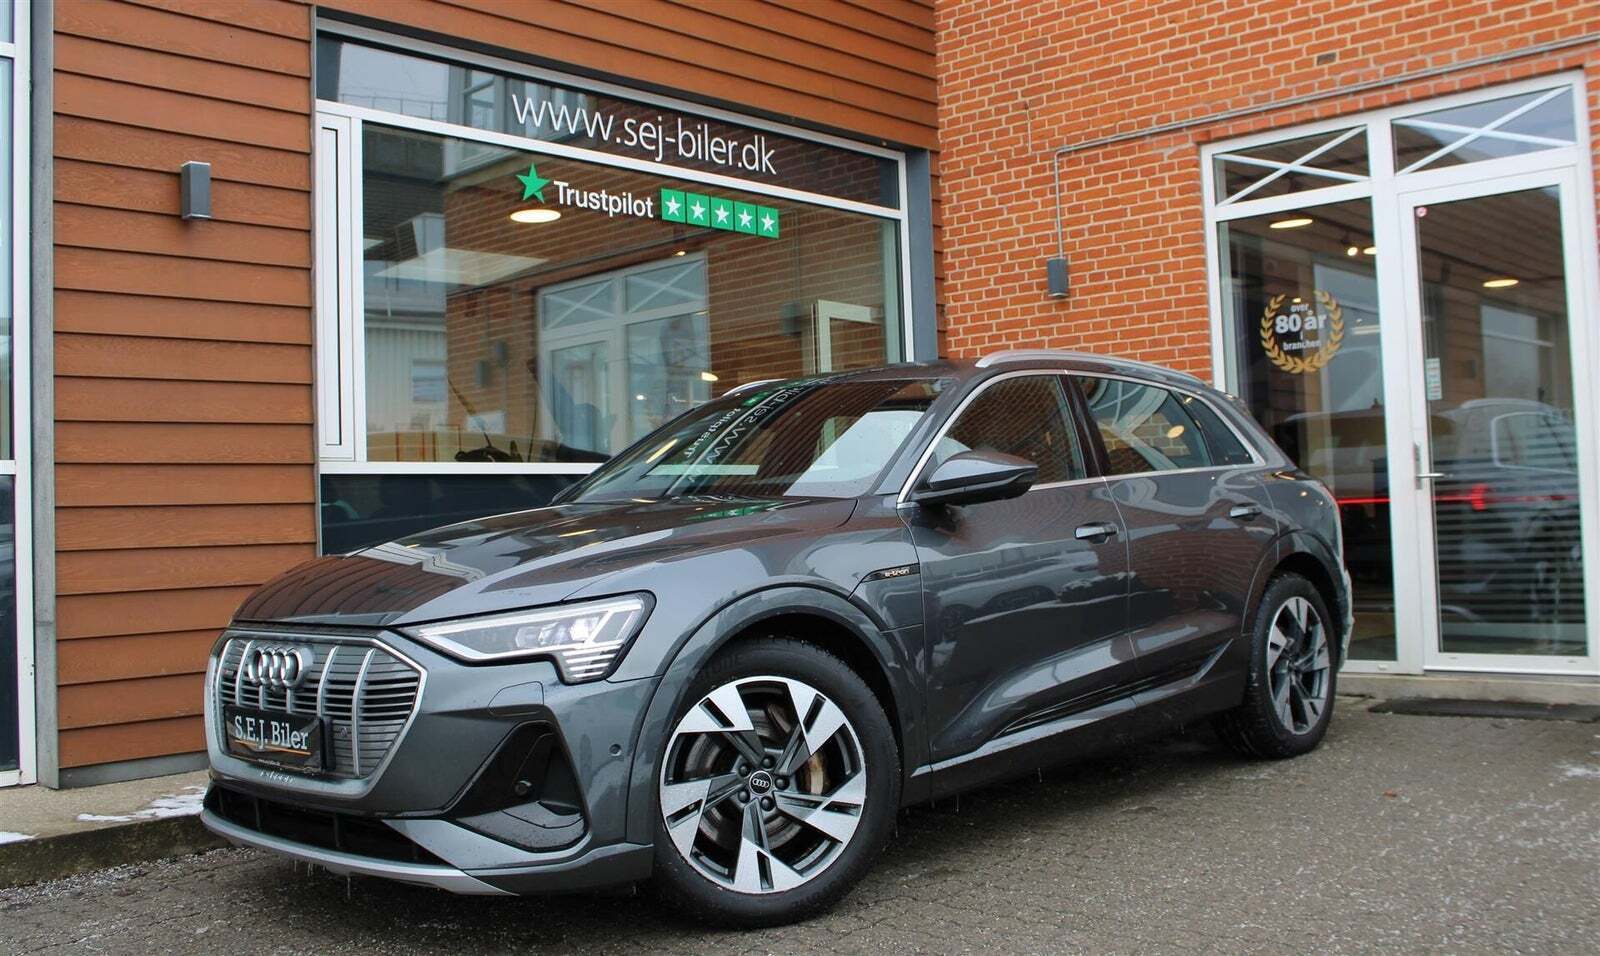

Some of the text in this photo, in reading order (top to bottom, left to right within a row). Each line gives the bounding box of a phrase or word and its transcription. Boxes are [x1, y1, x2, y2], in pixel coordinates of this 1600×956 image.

[512, 94, 777, 175] www.sej-biler.dk
[553, 180, 654, 219] Trustpilot
[1275, 309, 1328, 334] 80 år
[1290, 304, 1310, 313] over
[884, 567, 910, 578] e-tron
[234, 715, 309, 750] S.E.J. Biler
